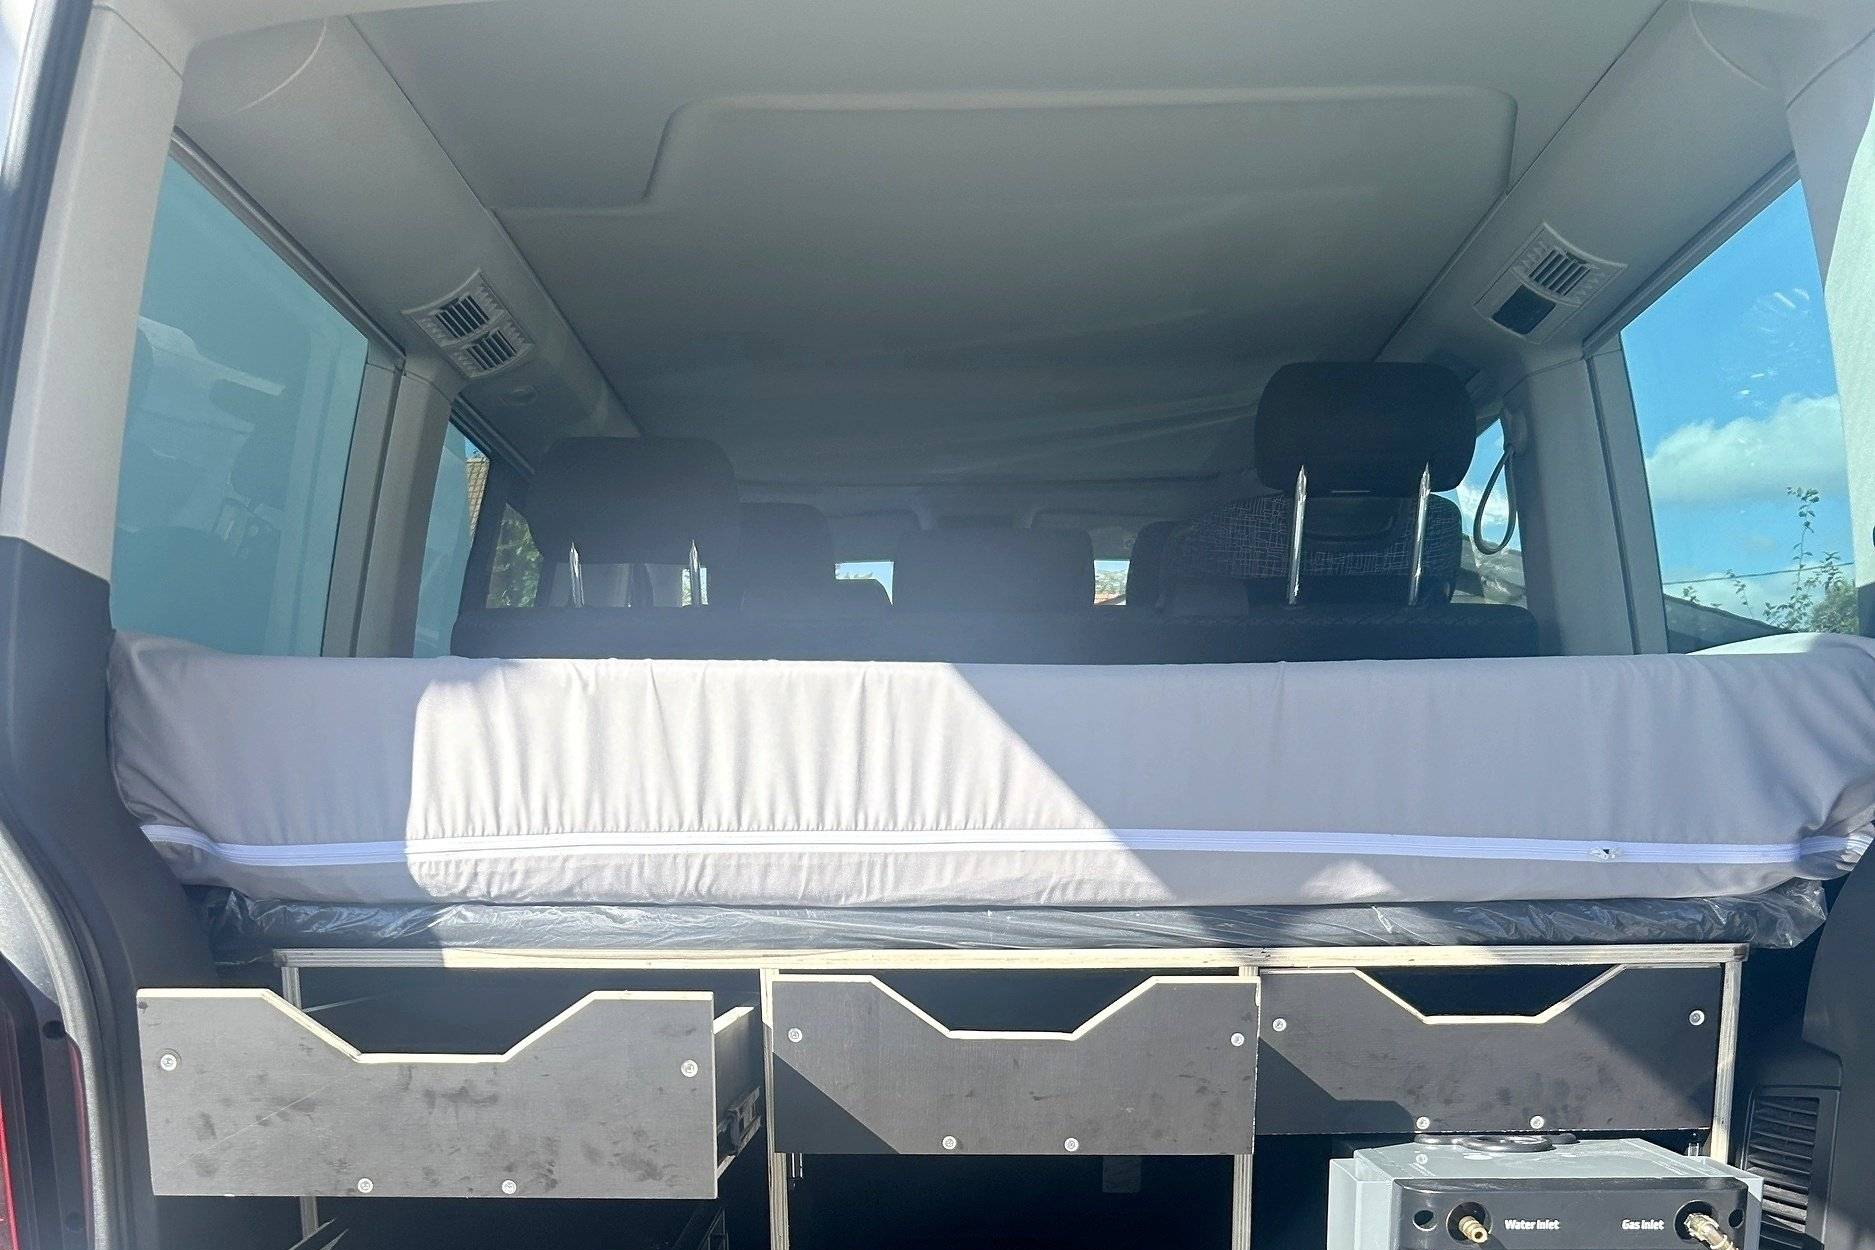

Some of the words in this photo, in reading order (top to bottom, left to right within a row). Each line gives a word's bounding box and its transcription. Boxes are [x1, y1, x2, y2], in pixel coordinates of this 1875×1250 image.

[1504, 1219, 1536, 1230] Water
[1536, 1219, 1560, 1230] Inlet
[1621, 1219, 1640, 1230] Gas
[1641, 1219, 1665, 1230] Inlet
